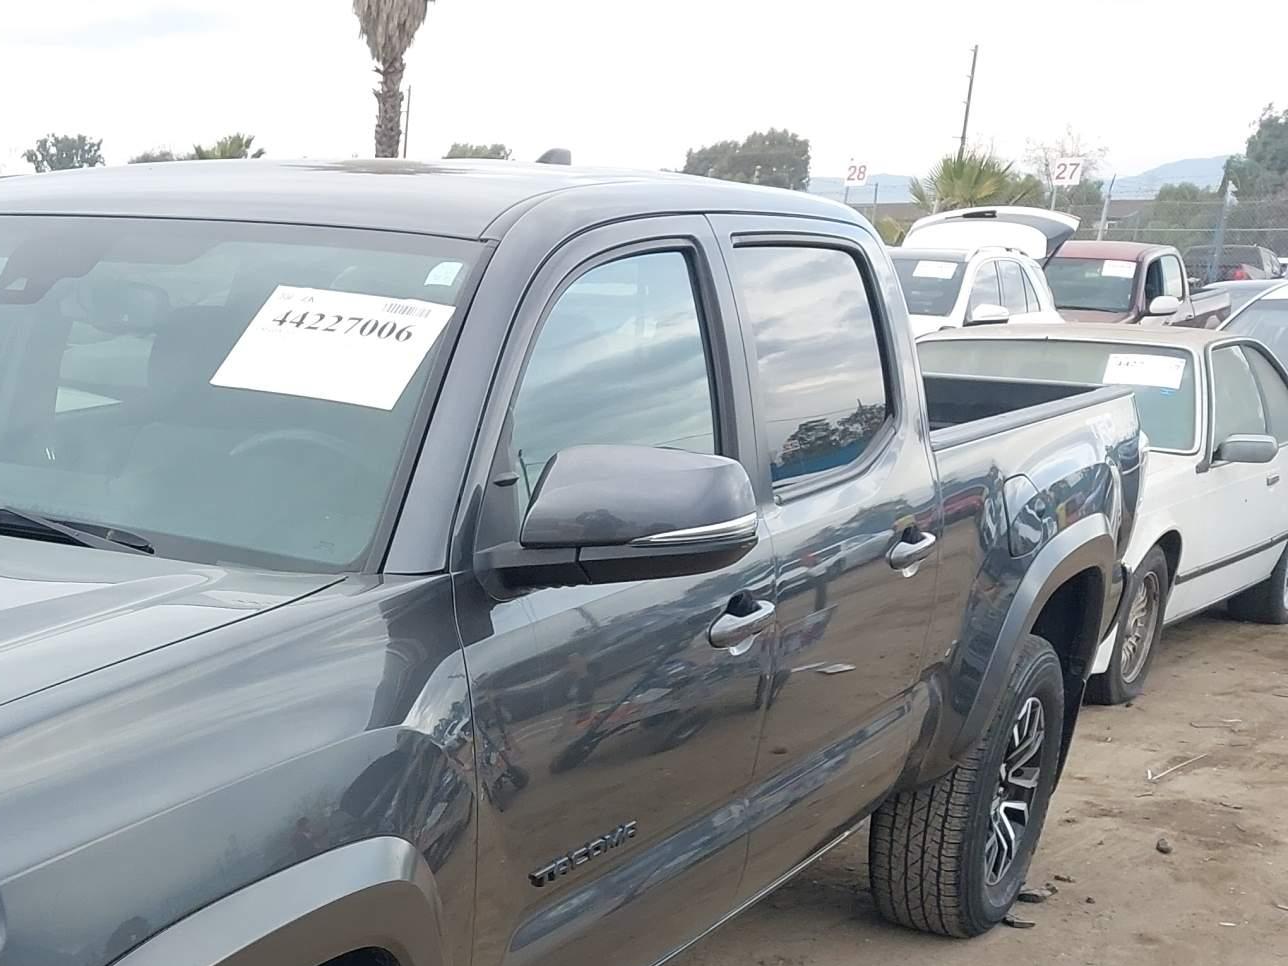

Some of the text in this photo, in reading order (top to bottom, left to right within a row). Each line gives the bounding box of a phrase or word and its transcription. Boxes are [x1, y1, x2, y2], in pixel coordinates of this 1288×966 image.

[847, 165, 867, 181] 28
[1055, 162, 1081, 180] 27
[272, 309, 416, 342] 44227006
[528, 819, 638, 888] TACOMA
